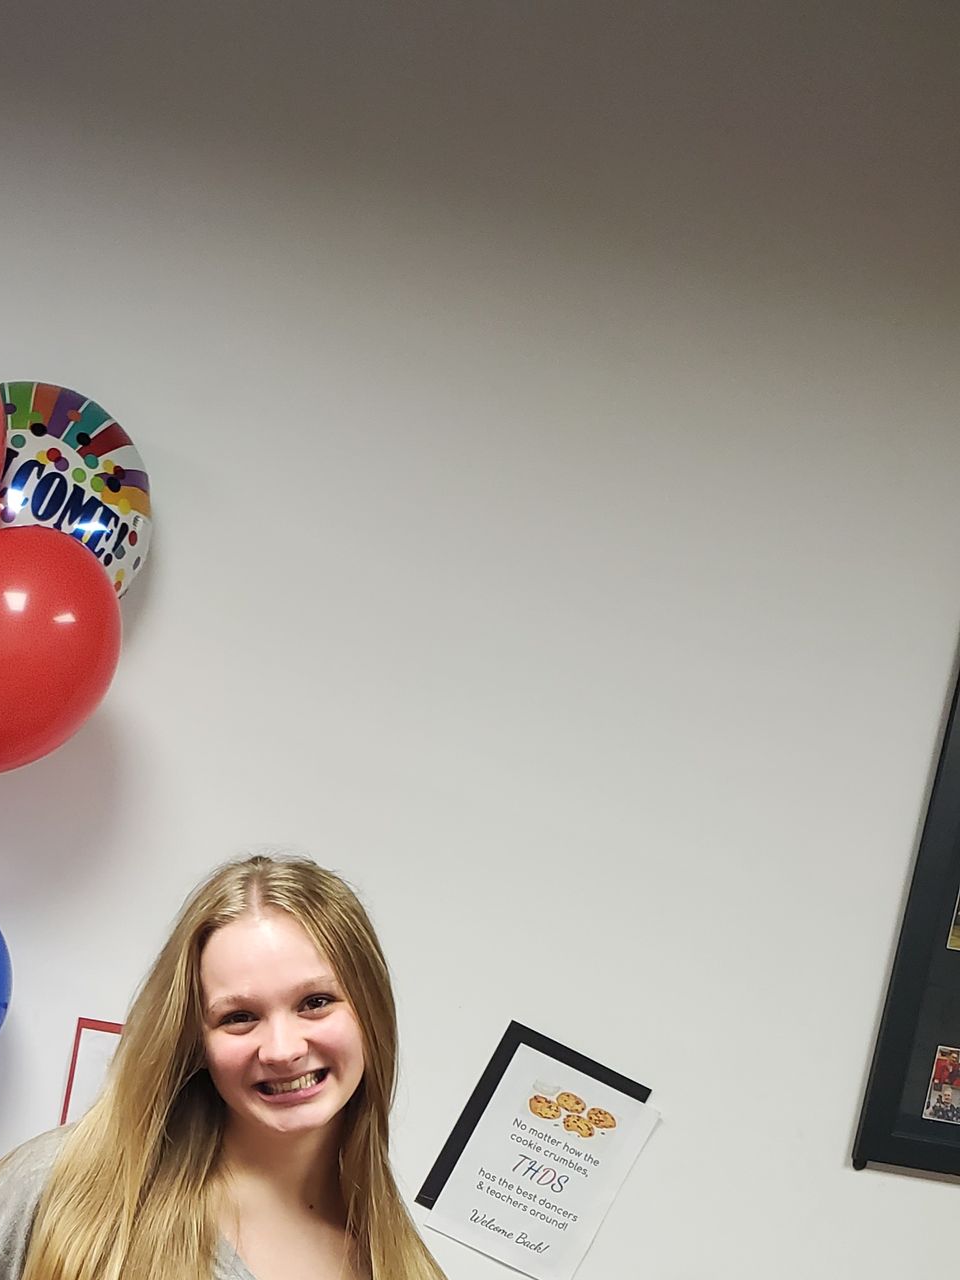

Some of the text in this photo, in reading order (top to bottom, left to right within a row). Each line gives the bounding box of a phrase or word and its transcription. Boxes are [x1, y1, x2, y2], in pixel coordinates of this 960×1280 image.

[510, 1133, 590, 1177] cookie crumbles,
[513, 1118, 600, 1167] No matter how the
[479, 1168, 578, 1222] has the best dancers
[512, 1154, 569, 1193] THDS
[476, 1181, 568, 1231] & teachers around!
[469, 1209, 549, 1254] Welcome Back!
